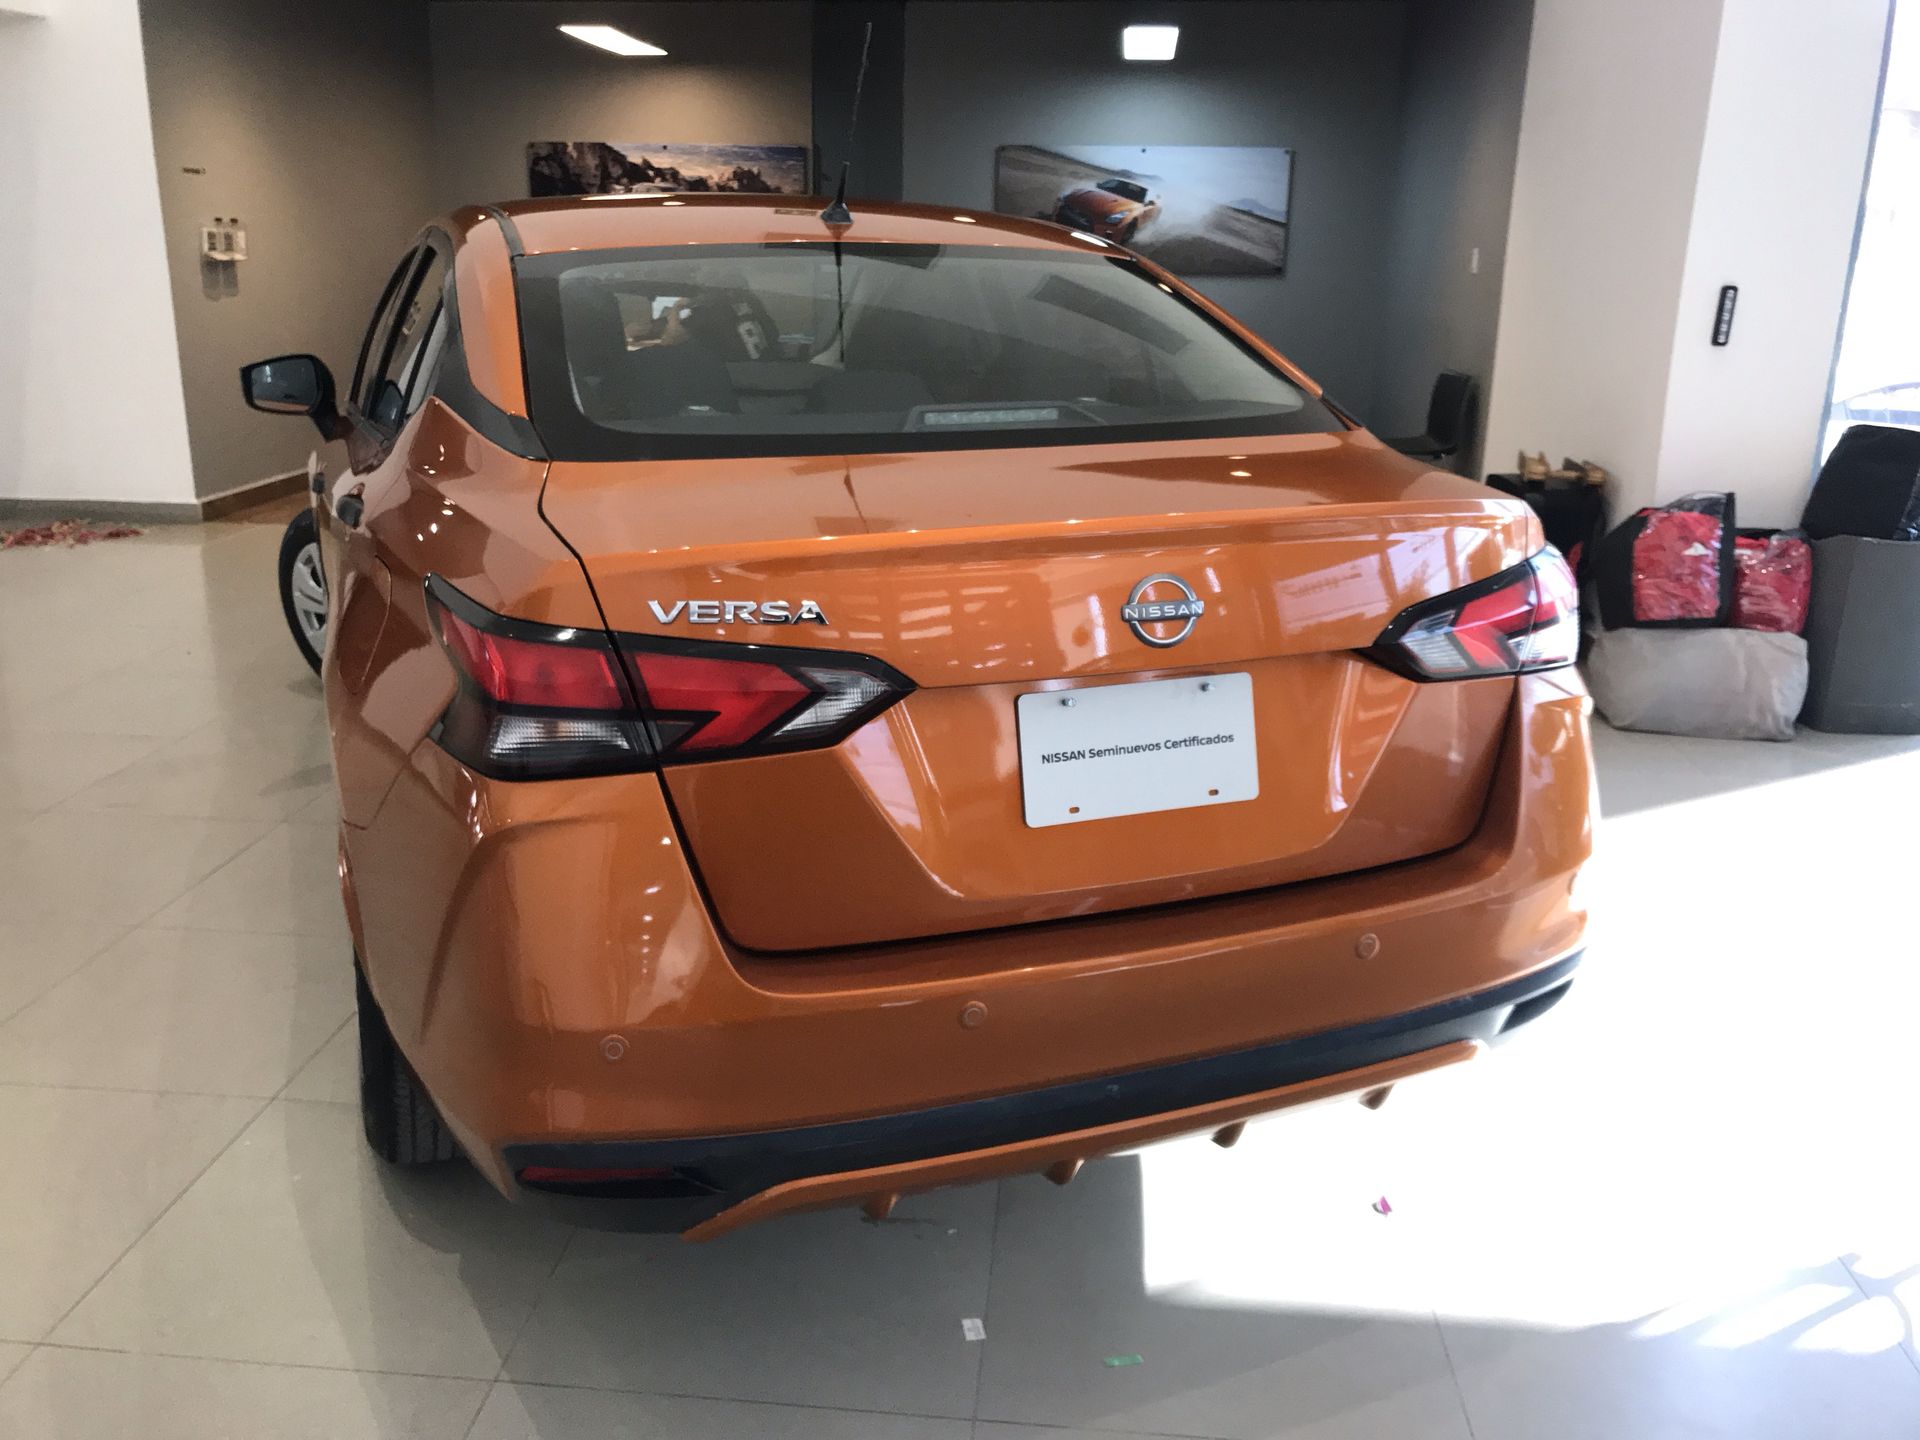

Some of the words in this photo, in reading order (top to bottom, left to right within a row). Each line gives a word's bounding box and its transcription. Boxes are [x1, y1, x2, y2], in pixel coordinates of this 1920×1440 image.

[648, 600, 829, 625] VERSA
[1124, 603, 1204, 619] NISSAN
[1041, 749, 1086, 764] NISSAN
[1088, 741, 1162, 759] Seminuevos
[1164, 733, 1235, 750] Certificados
